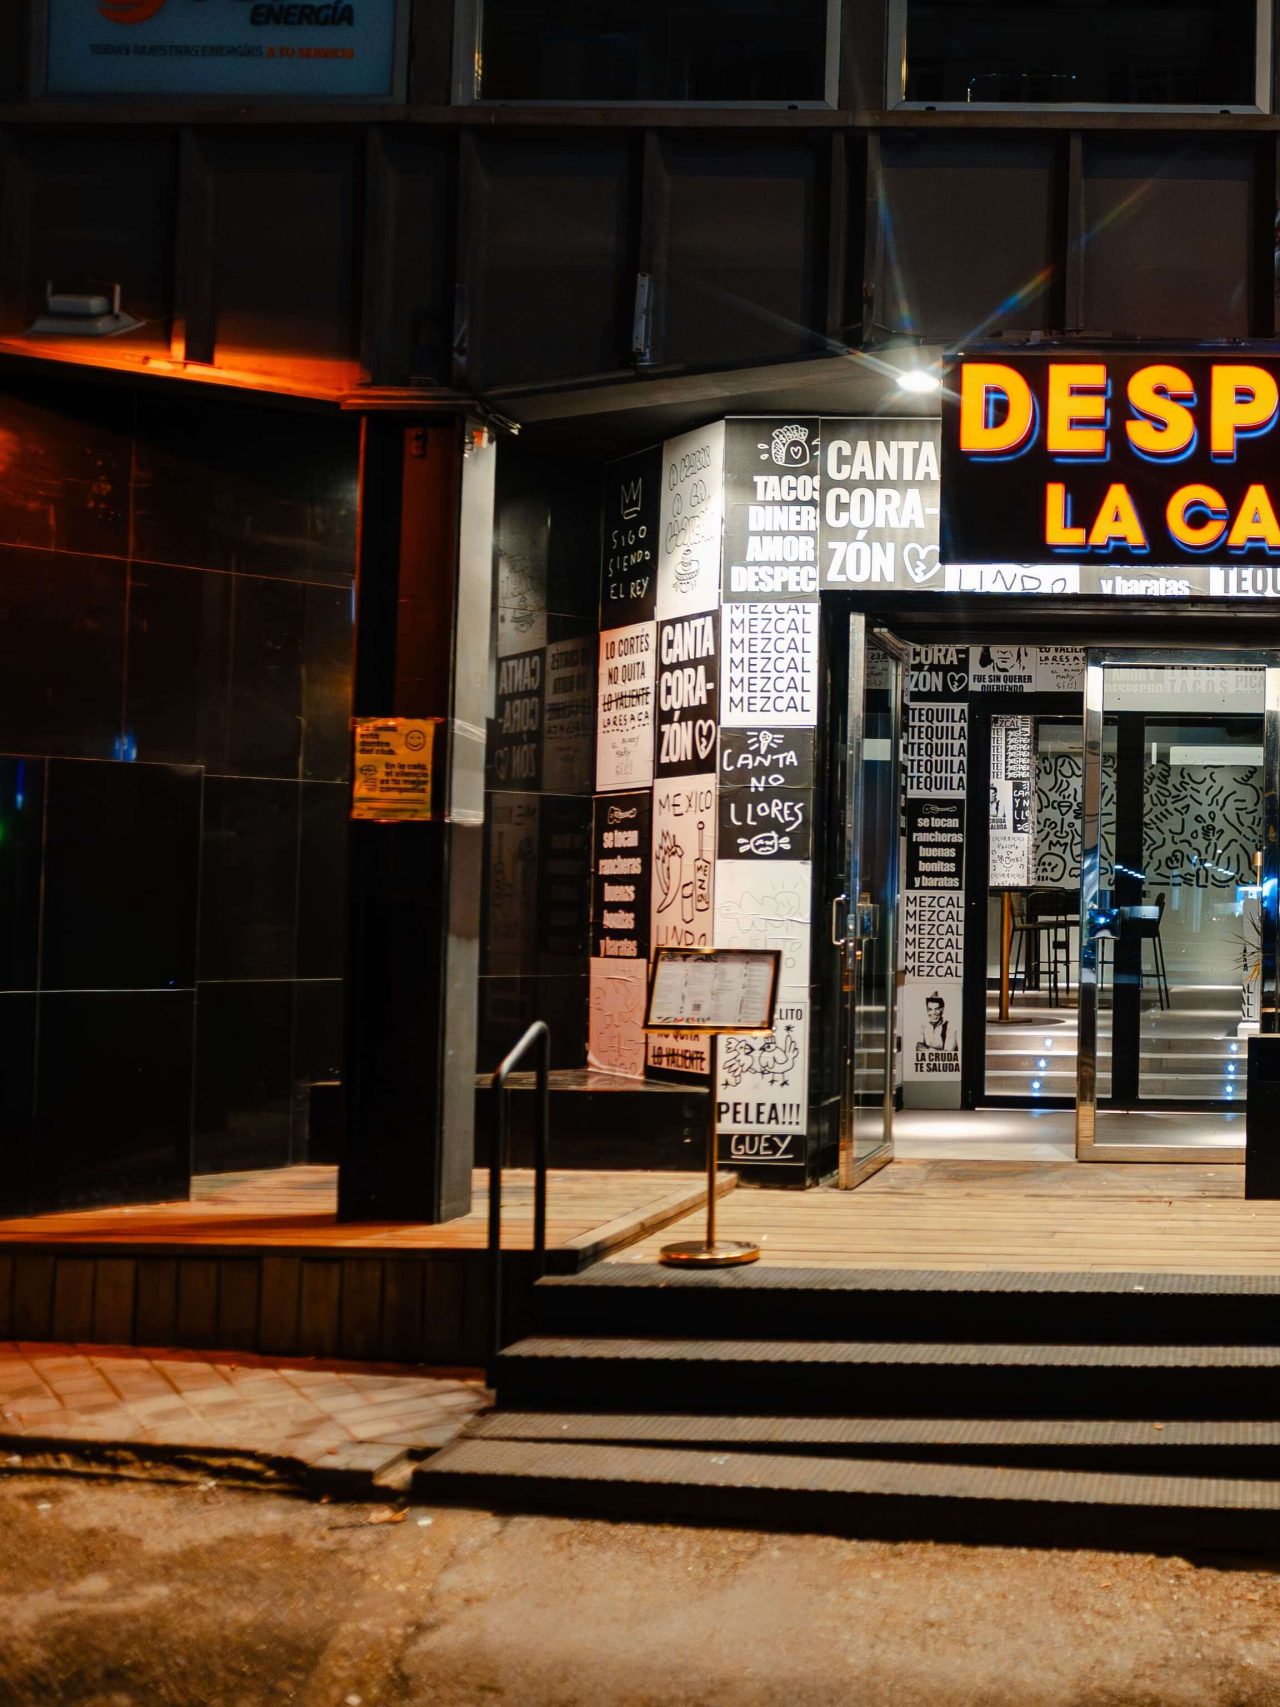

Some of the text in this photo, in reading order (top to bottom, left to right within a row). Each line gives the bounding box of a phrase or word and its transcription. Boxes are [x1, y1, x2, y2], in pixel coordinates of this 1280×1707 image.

[250, 0, 355, 26] ENERGÍA
[826, 439, 941, 481] CANTA
[825, 487, 940, 529] CORA-
[1045, 481, 1150, 554] LA
[612, 525, 647, 550] SIGO
[745, 535, 815, 562] AMOR
[826, 529, 896, 583] ZÓN
[608, 550, 651, 578] SIENDO
[610, 576, 650, 600] EL REY
[1115, 576, 1191, 596] baratas
[730, 618, 812, 634] MEZCAL
[605, 628, 650, 661] LO CORTÉS
[661, 615, 715, 666] CANTA
[730, 637, 812, 653] MEZCAL
[607, 667, 619, 686] NO
[621, 661, 646, 684] QUITA
[730, 657, 812, 673] MEZCAL
[730, 676, 812, 692] MEZCAL
[909, 665, 943, 692] ZÓN
[972, 674, 1033, 685] FUE SIN QUERER
[660, 665, 715, 712] CORA-
[730, 696, 812, 713] MEZCAL
[908, 708, 967, 725] TEQUILA
[660, 710, 694, 764] ZÓN
[908, 725, 967, 742] TEQUILA
[908, 742, 967, 759] TEQUILA
[722, 749, 799, 771] CANTA
[908, 759, 967, 776] TEQUILA
[750, 774, 785, 793] NO
[908, 776, 967, 792] TEQUILA
[658, 789, 713, 817] MEXICO
[730, 798, 805, 832] LLORES
[917, 816, 960, 828] se tocan
[912, 831, 964, 843] rancheras
[918, 846, 956, 858] buenas
[918, 860, 956, 873] bonitas
[914, 875, 960, 888] y baratas
[904, 895, 964, 908] MEZCAL
[904, 909, 964, 922] MEZCAL
[904, 923, 964, 936] MEZCAL
[904, 937, 964, 950] MEZCAL
[904, 951, 964, 964] MEZCAL
[904, 965, 964, 978] MEZCAL
[915, 1052, 959, 1062] LA CRUDA
[914, 1062, 961, 1073] TE SALUDA
[717, 1101, 801, 1126] PELEA!!!
[730, 1134, 793, 1158] GUEY
